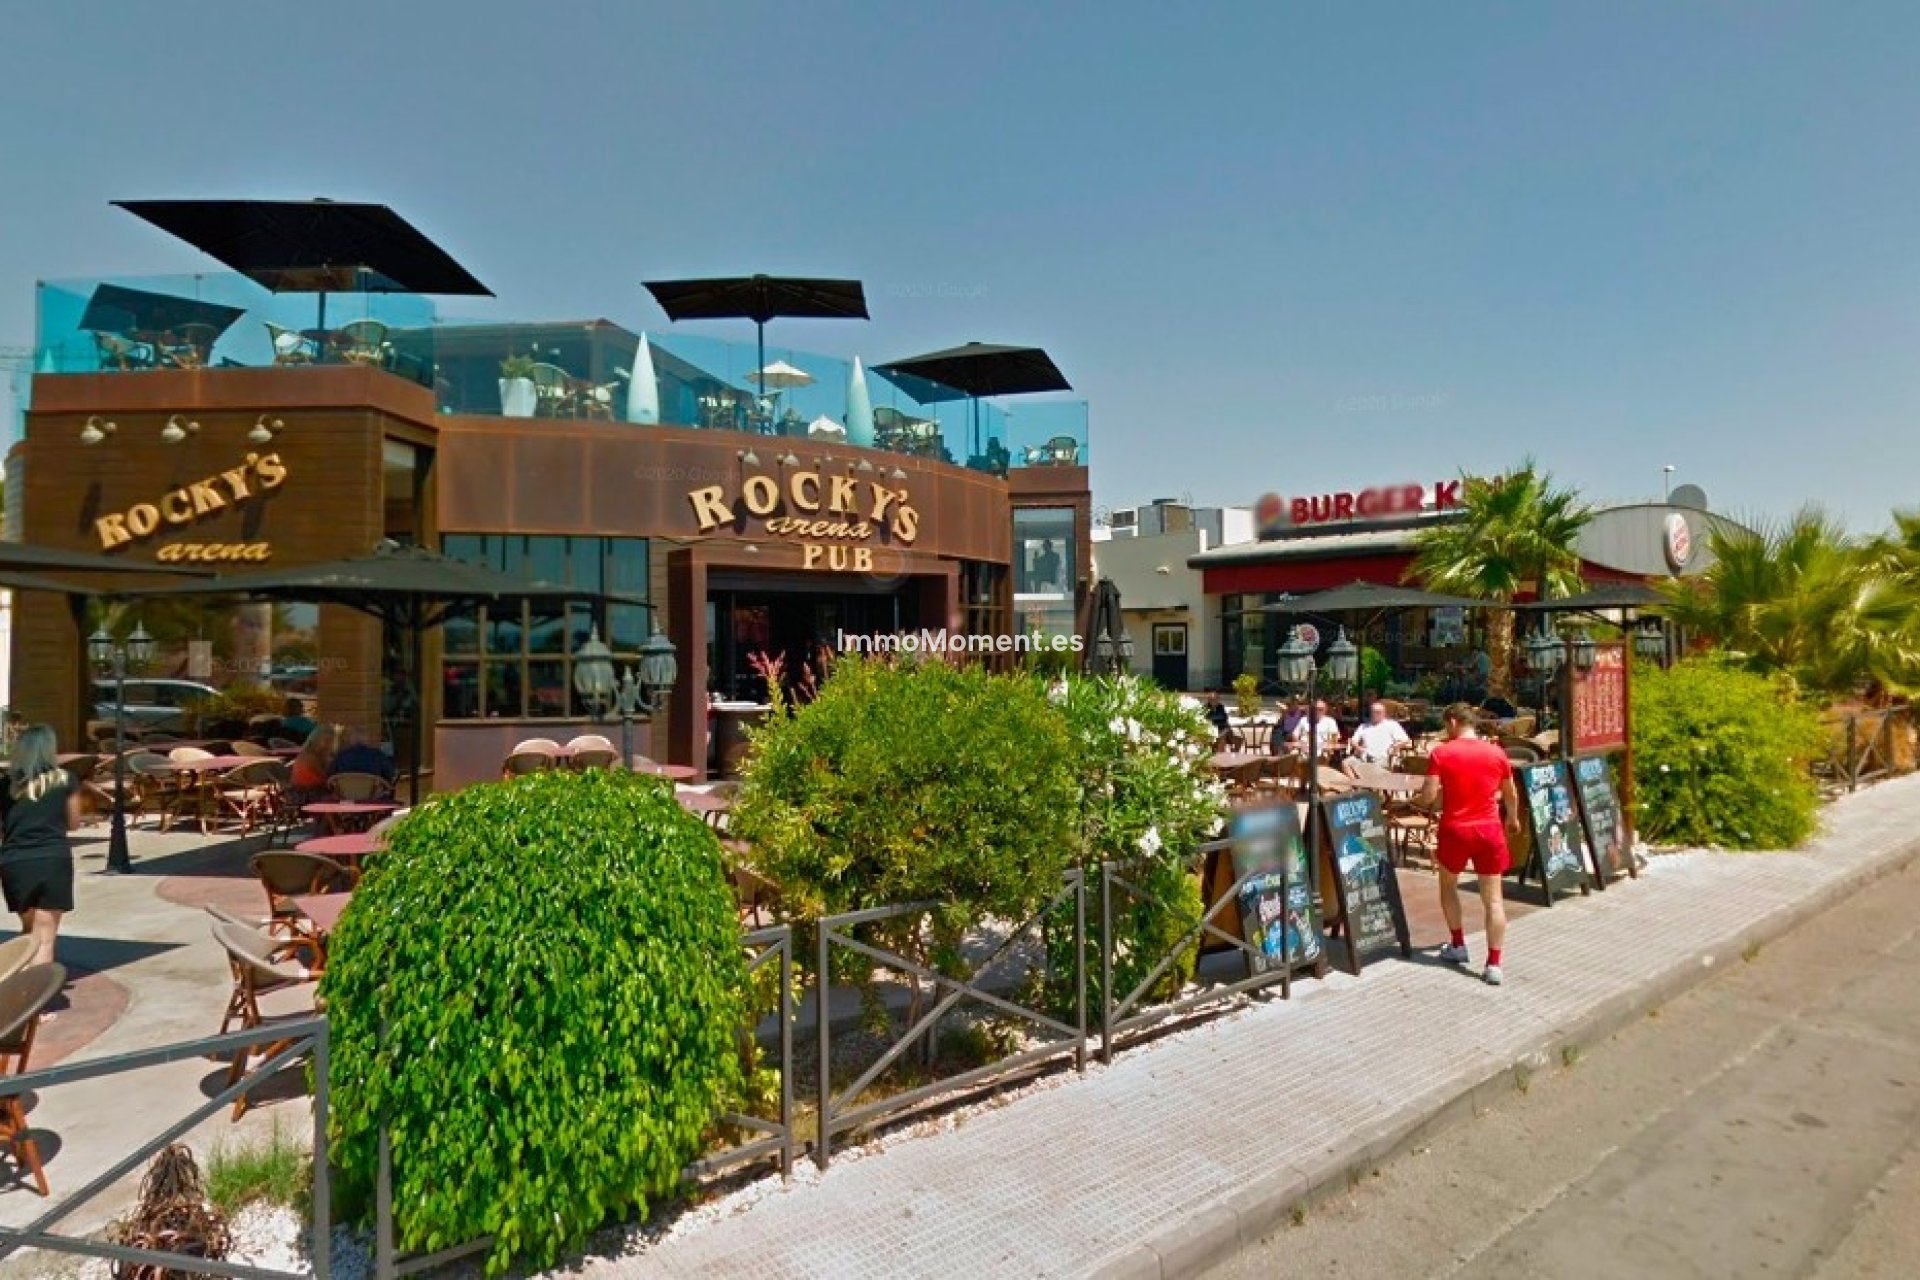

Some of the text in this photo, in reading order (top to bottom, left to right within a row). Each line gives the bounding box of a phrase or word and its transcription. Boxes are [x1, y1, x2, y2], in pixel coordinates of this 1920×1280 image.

[95, 452, 287, 549] ROCKY'S
[688, 471, 919, 542] ROCKY'S
[1290, 484, 1424, 524] BURGER
[765, 516, 871, 539] arena
[156, 541, 272, 561] arena
[804, 543, 873, 572] PUB
